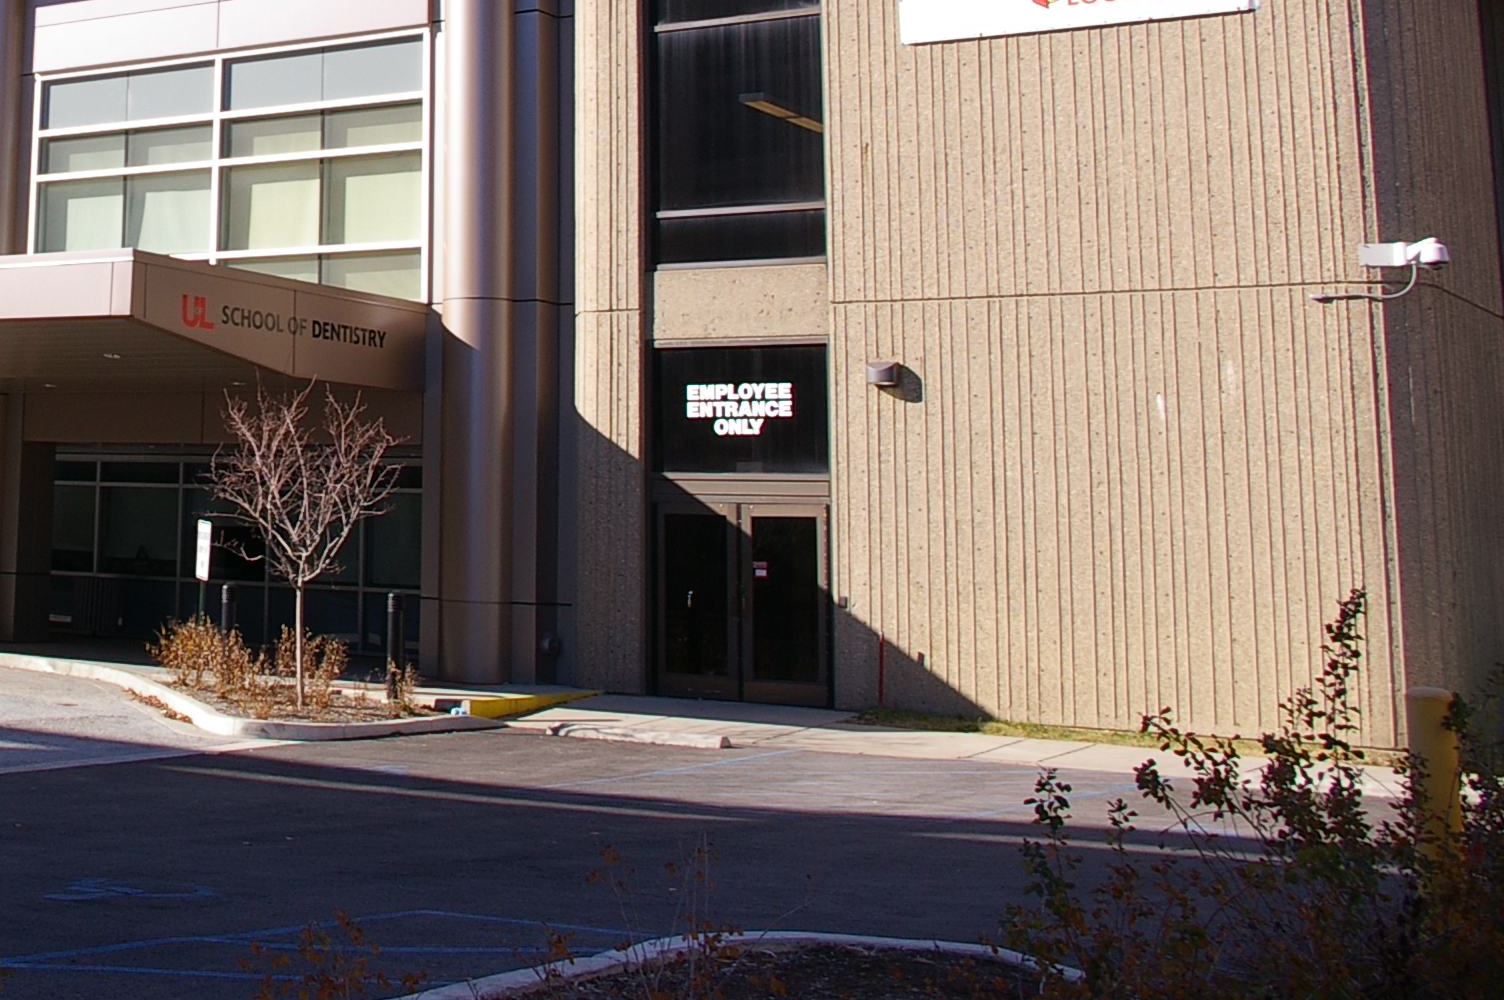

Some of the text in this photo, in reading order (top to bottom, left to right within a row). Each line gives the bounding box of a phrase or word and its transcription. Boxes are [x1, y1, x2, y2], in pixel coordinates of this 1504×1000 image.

[222, 305, 284, 333] SCHOOL
[288, 316, 308, 337] OF
[312, 320, 387, 349] DENTISTRY
[686, 383, 793, 401] EMPLOYEE
[686, 401, 793, 418] ENTRANCE
[713, 418, 766, 436] ONLY
